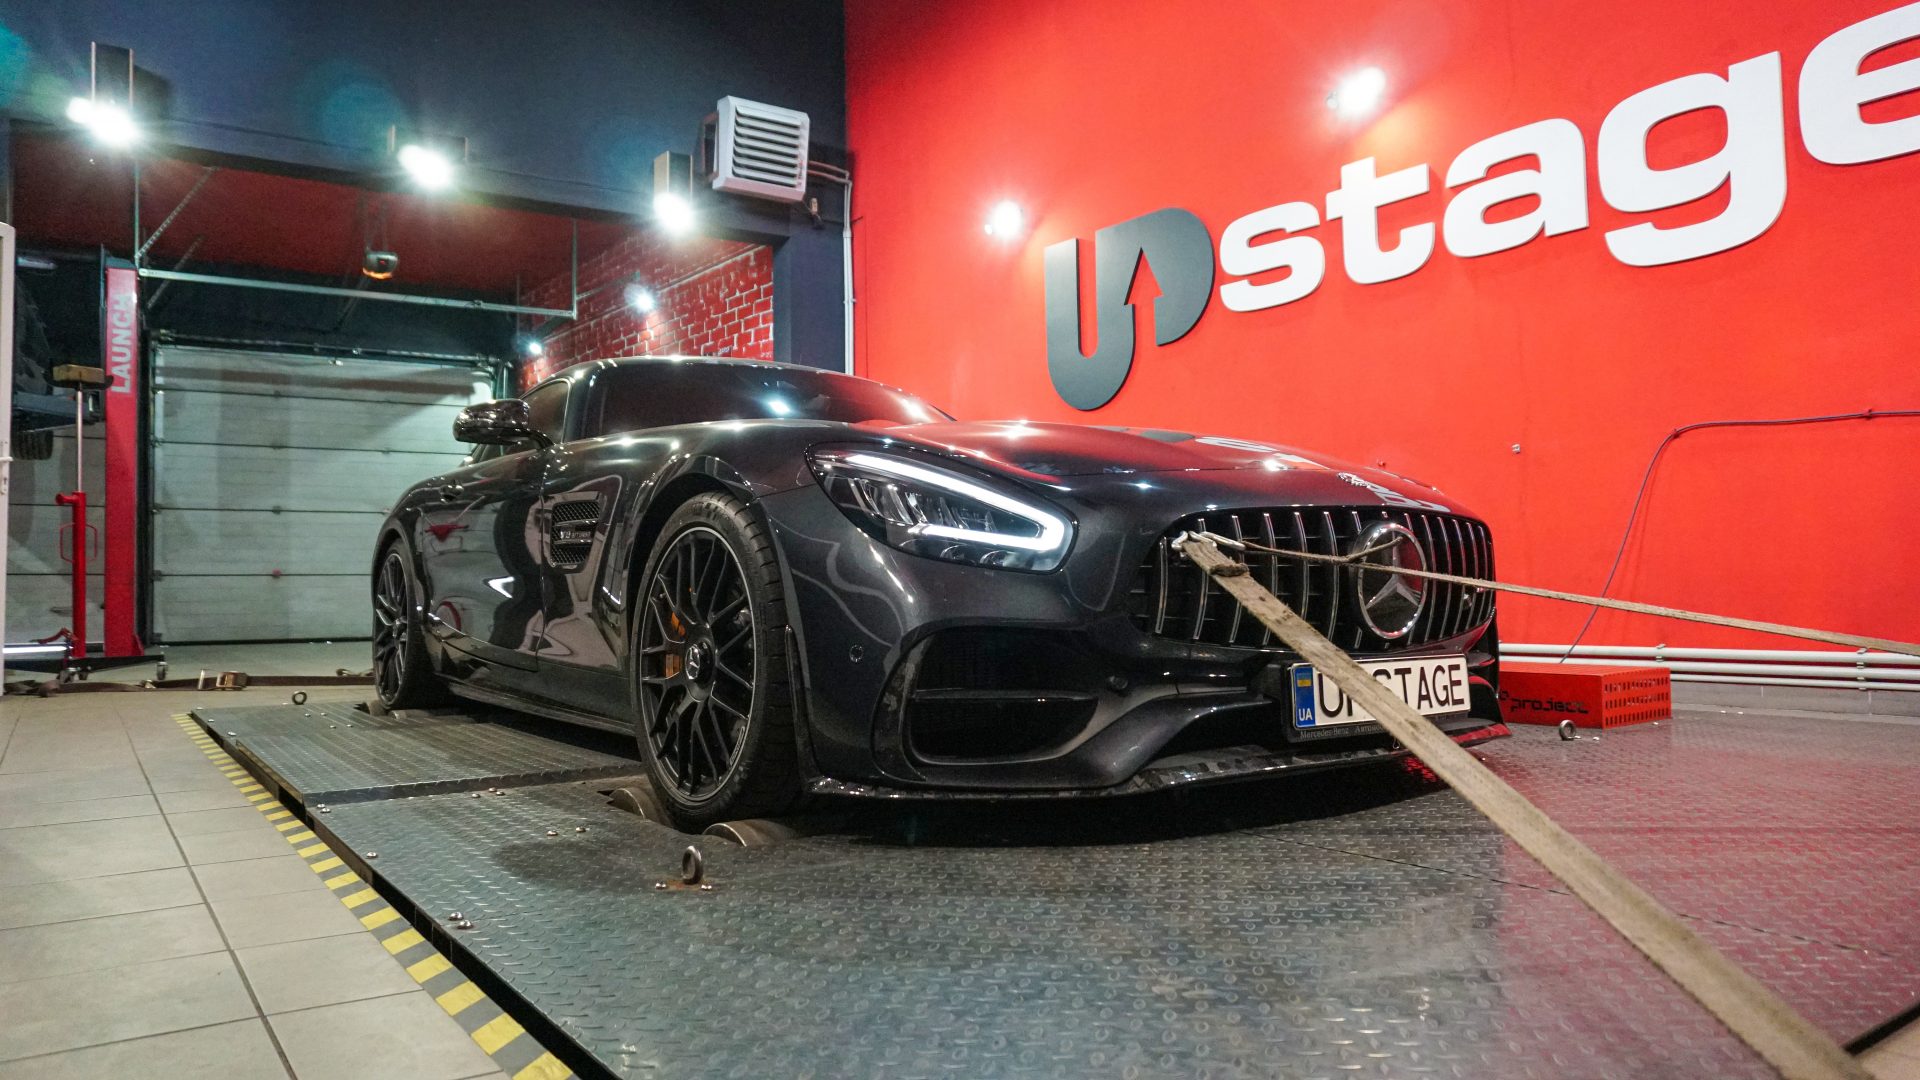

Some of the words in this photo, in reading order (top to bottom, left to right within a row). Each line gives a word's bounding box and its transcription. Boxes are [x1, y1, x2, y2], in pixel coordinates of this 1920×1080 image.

[111, 292, 132, 394] LAUNCH
[1298, 708, 1313, 721] UA
[1317, 664, 1465, 718] UTAGE
